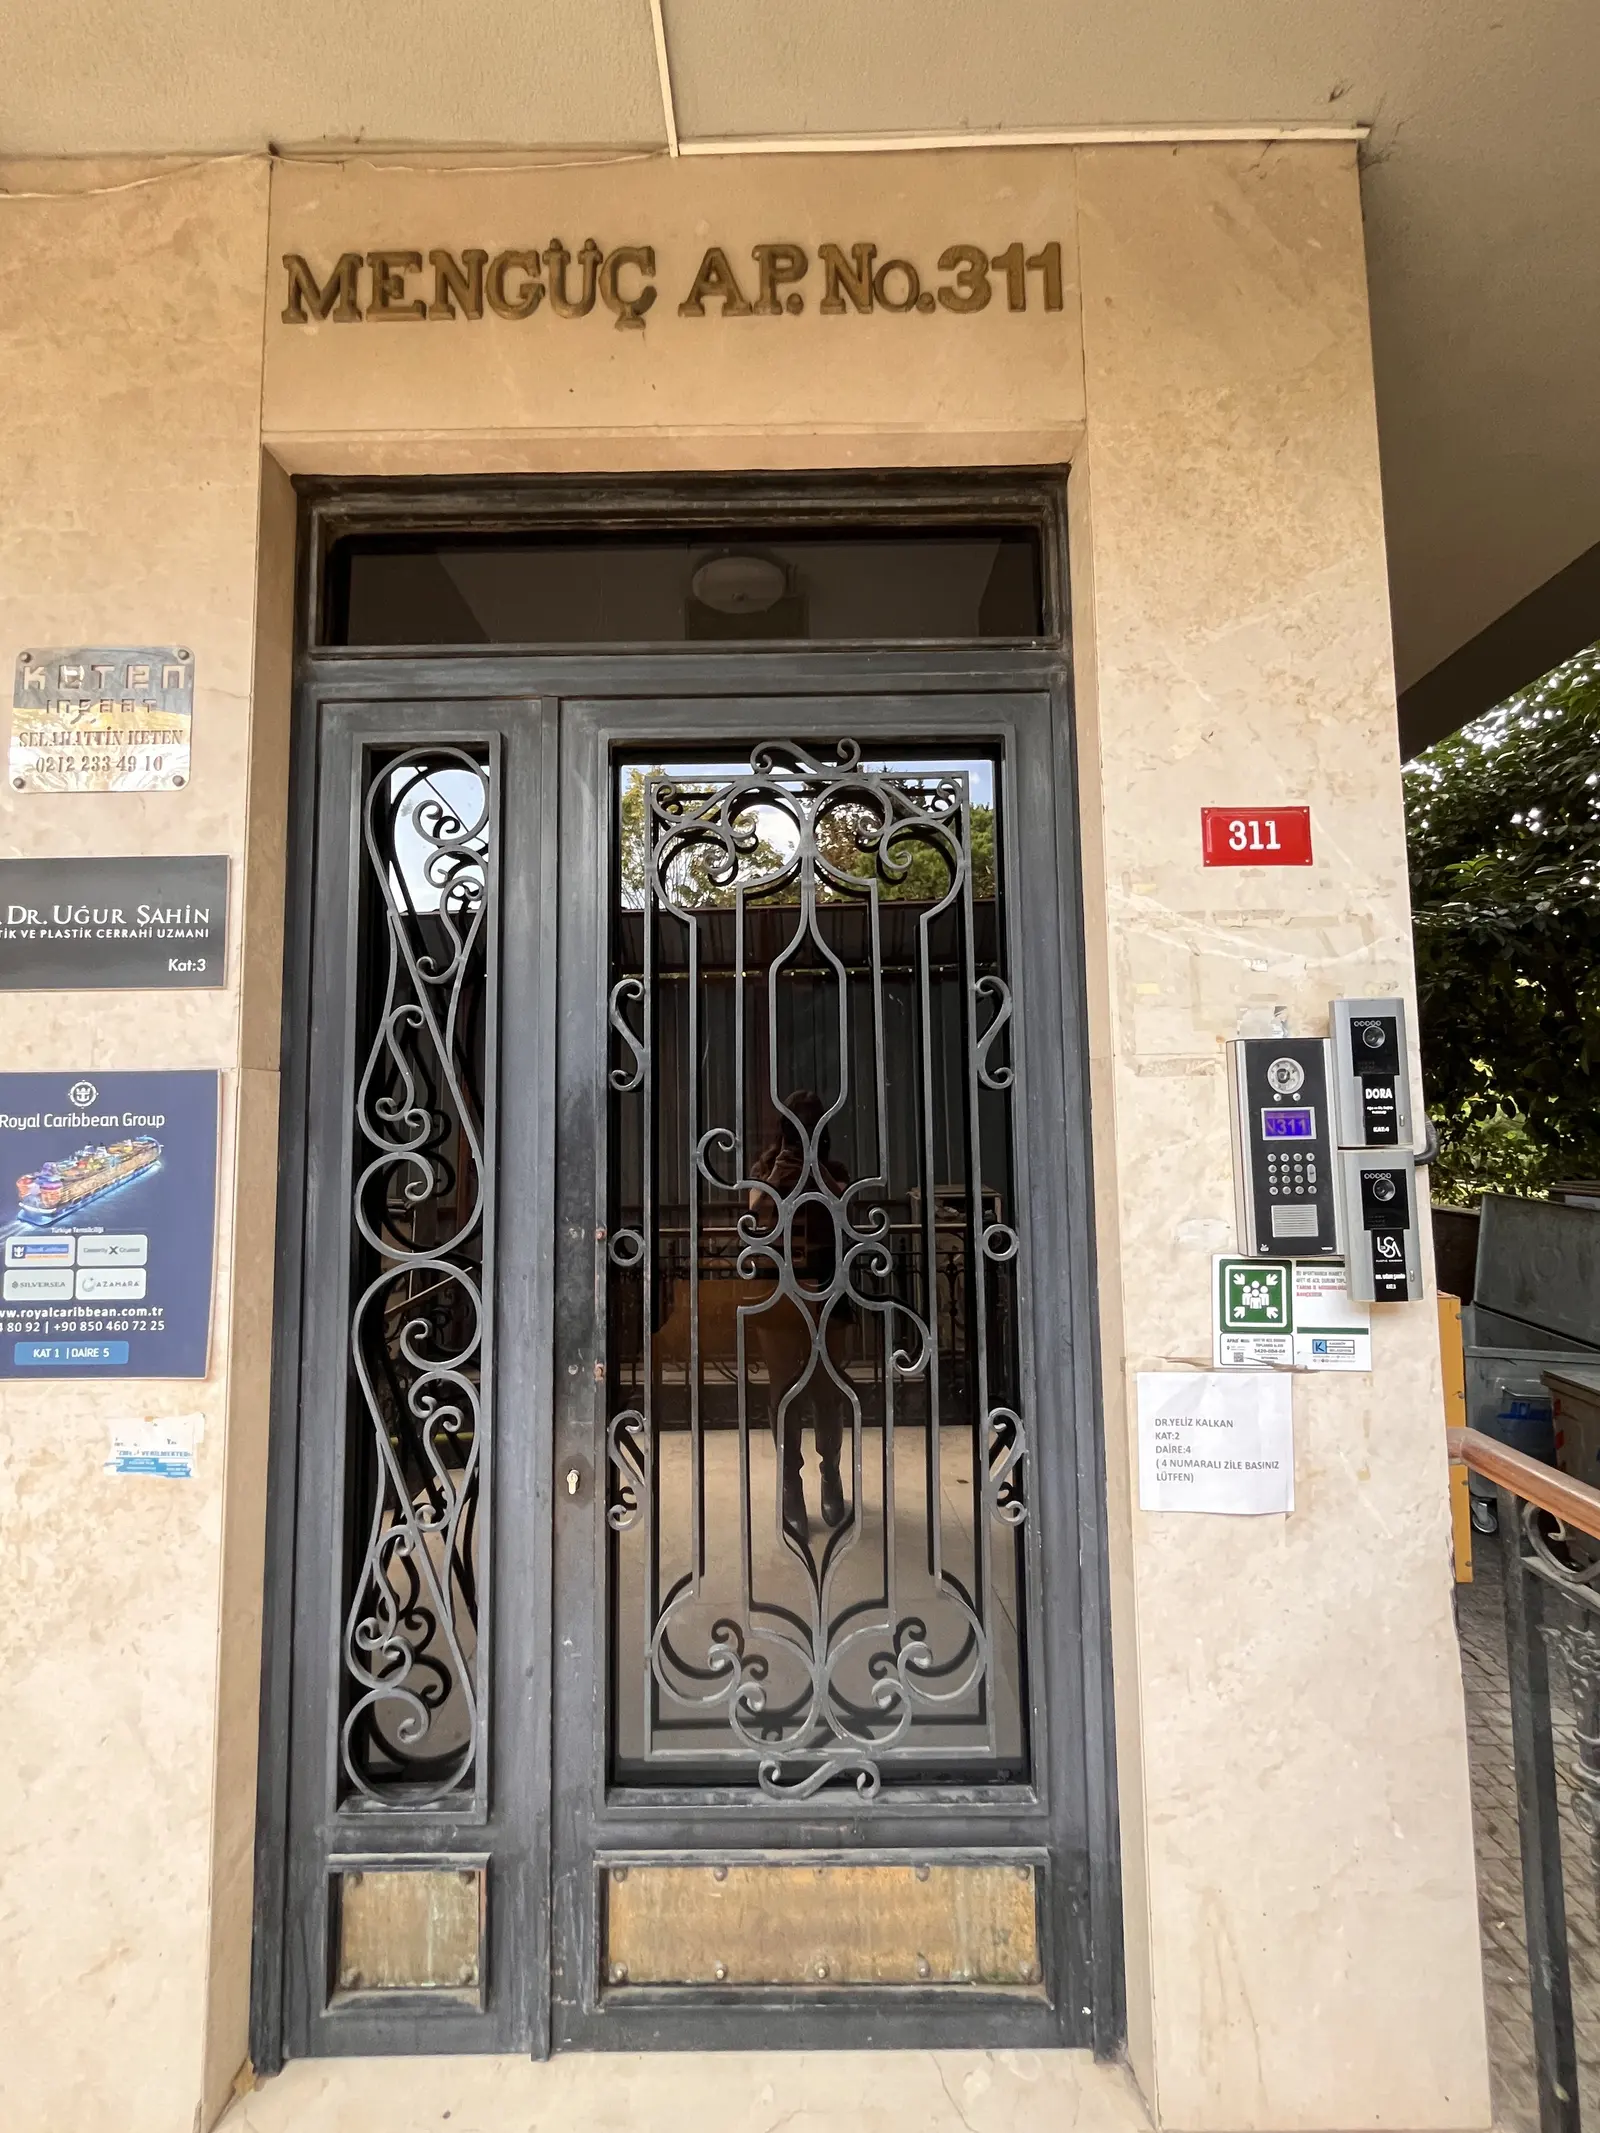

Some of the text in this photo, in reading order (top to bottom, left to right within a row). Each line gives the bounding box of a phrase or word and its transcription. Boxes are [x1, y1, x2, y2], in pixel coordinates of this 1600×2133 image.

[281, 238, 657, 330] MENGÜÇ
[127, 730, 184, 746] KETEN
[35, 756, 77, 773] 0212
[145, 755, 164, 772] 10
[1228, 819, 1281, 851] 311
[20, 929, 36, 939] VE
[40, 927, 92, 939] PLASTİK
[96, 927, 153, 939] CERRAHİ
[157, 928, 210, 939] UZMANI
[168, 958, 207, 972] Kat:3
[1365, 1088, 1393, 1099] DORA
[0, 1112, 165, 1130] Royal Caribbean Group
[7, 1322, 22, 1332] 80
[25, 1322, 40, 1332] 92
[54, 1321, 77, 1331] +90
[80, 1321, 103, 1331] 850
[106, 1320, 129, 1331] 460
[132, 1320, 147, 1331] 72
[150, 1320, 165, 1330] 25
[33, 1348, 51, 1358] KAT
[55, 1348, 59, 1357] 1
[72, 1346, 99, 1357] DAİRE
[1155, 1416, 1234, 1428] DR.YELİZ KALKAN
[1155, 1431, 1180, 1440] KAT:2
[1155, 1444, 1191, 1454] DAİRE:4
[1170, 1459, 1222, 1469] NUMARALI
[1224, 1459, 1243, 1470] ZİLE
[1245, 1460, 1280, 1470] BASINIZ
[1156, 1470, 1194, 1483] LÜTFEN)
